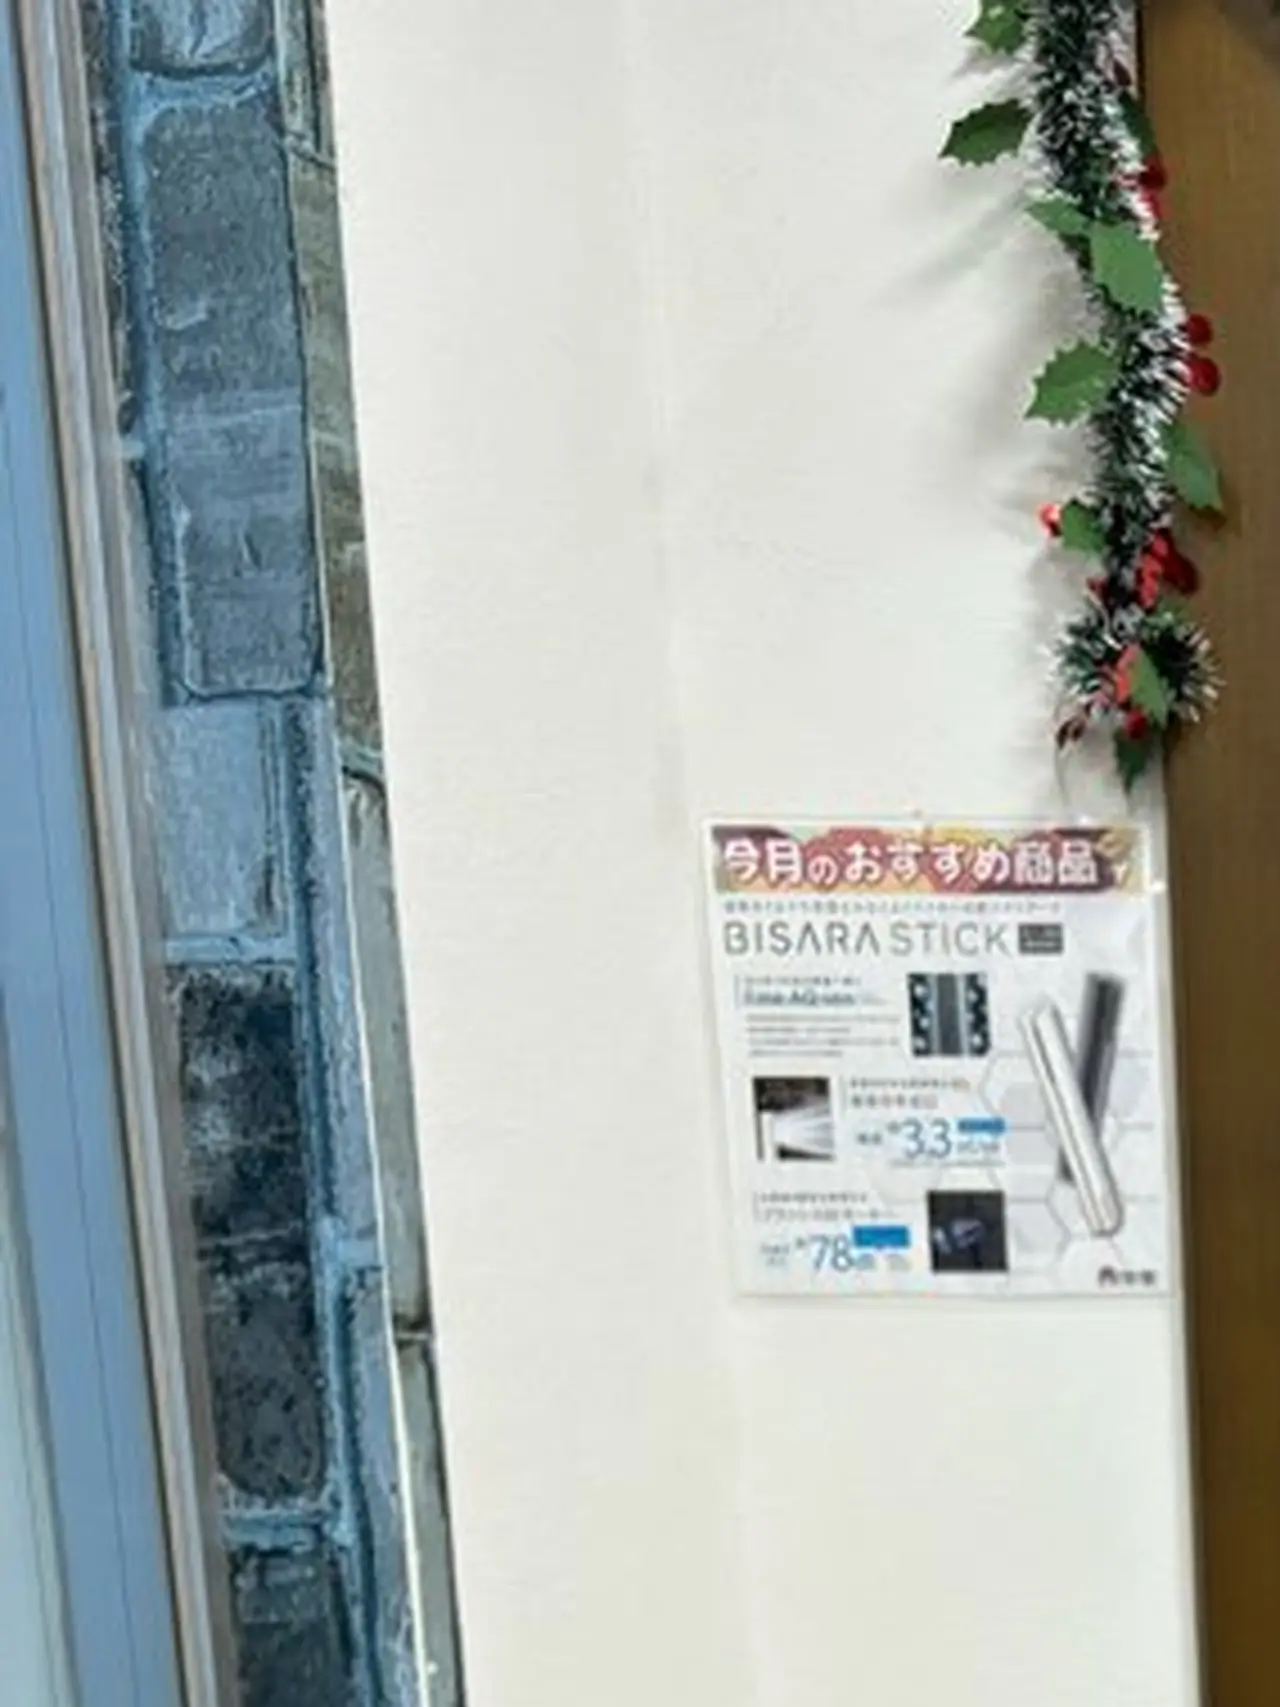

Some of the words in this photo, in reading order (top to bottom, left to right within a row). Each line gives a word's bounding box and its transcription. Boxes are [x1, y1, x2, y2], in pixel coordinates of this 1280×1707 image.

[723, 836, 1099, 886] 今月のおすすめ商品
[724, 921, 881, 957] BISARA
[888, 921, 1011, 957] STICK
